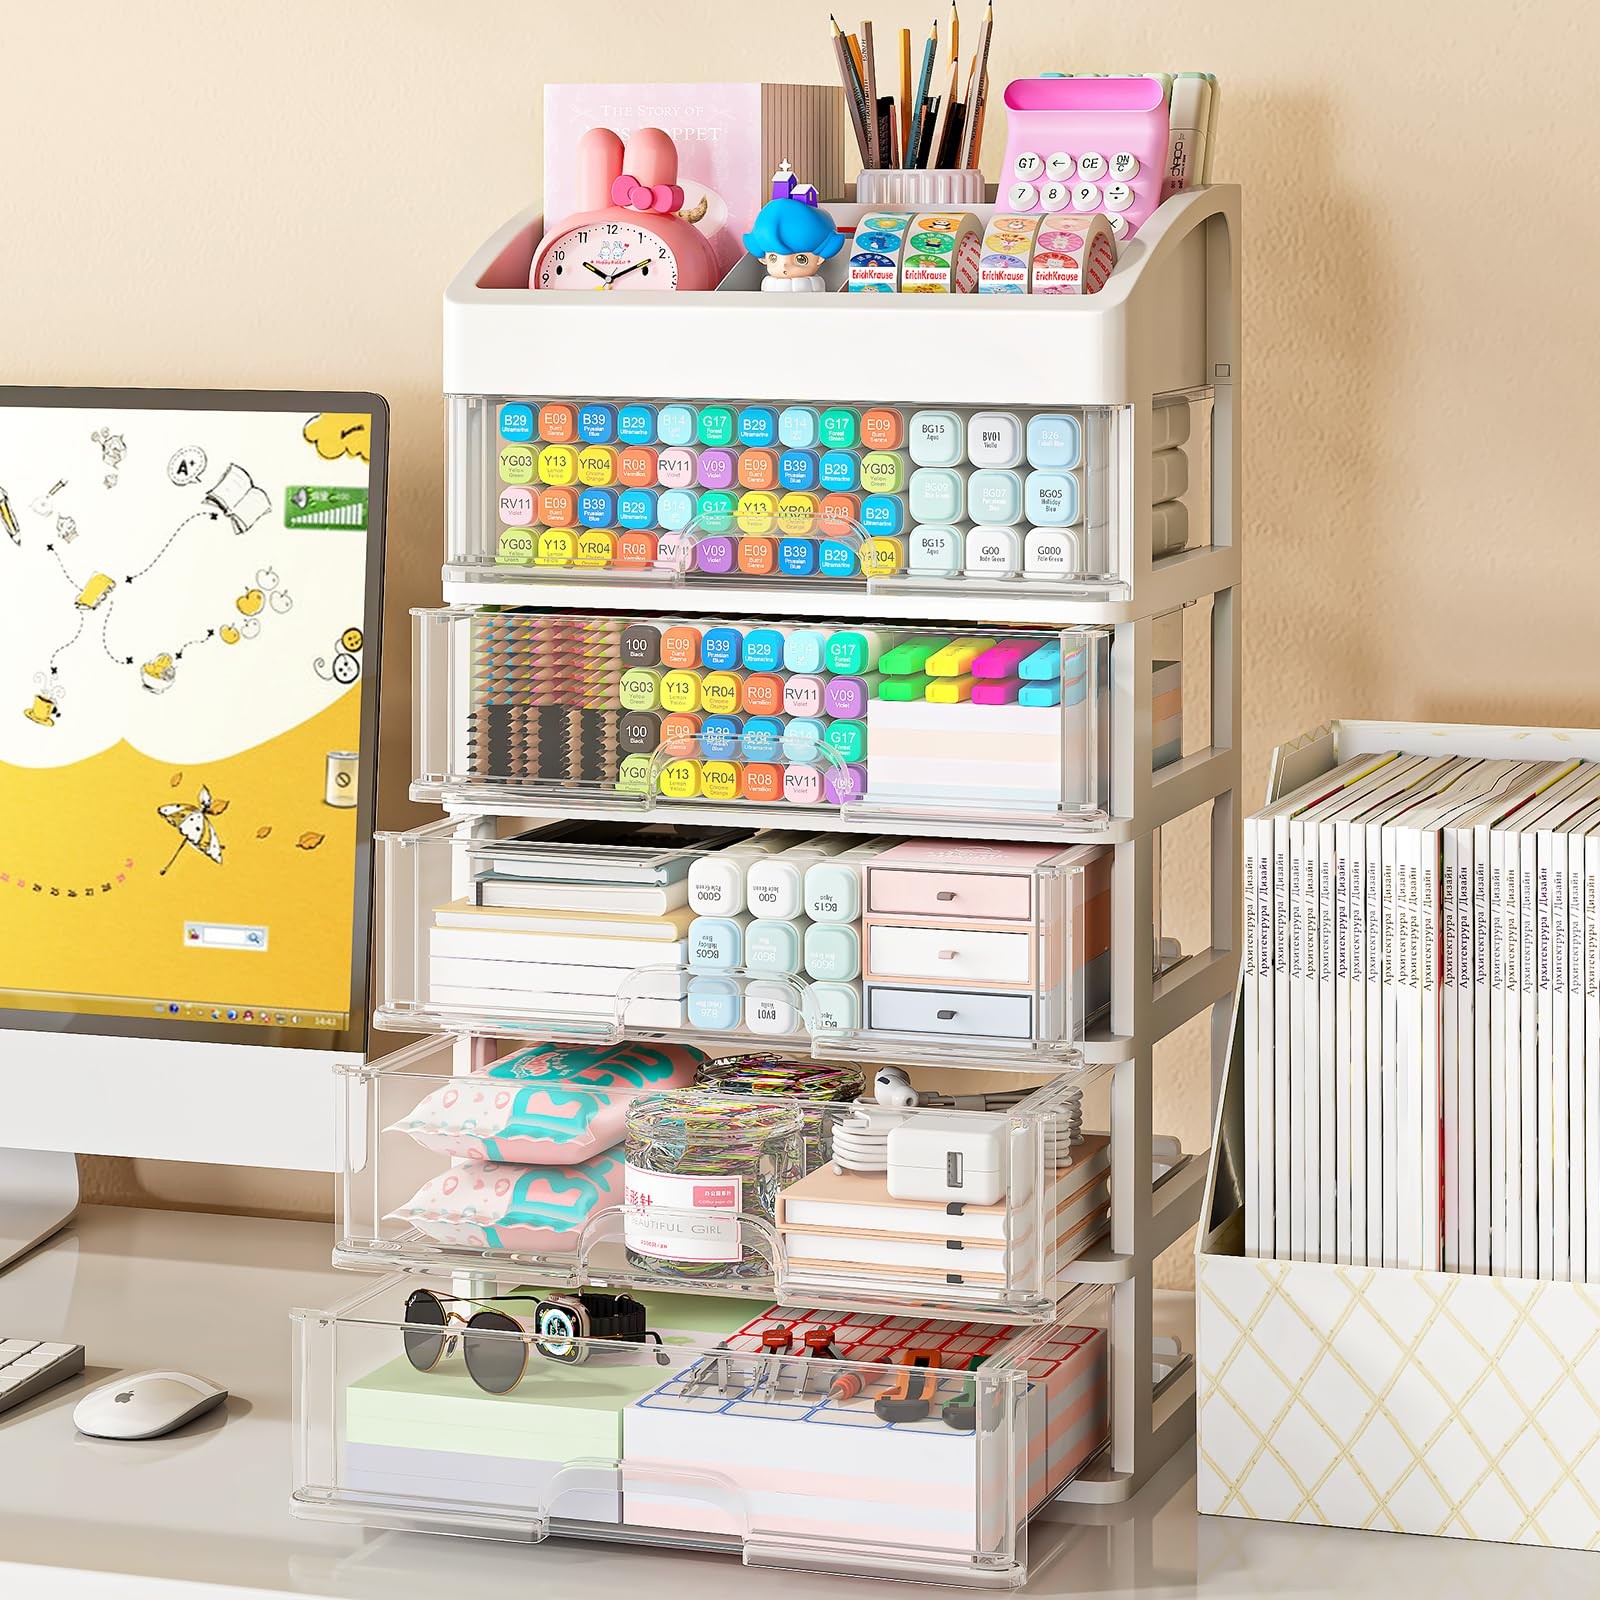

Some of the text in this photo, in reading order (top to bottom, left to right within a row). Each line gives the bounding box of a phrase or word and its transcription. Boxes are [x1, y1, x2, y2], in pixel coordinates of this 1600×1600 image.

[639, 105, 680, 117] STORY
[685, 106, 704, 116] OF
[1019, 158, 1035, 168] GT
[1083, 158, 1098, 168] CE
[1018, 189, 1025, 198] 7
[1049, 189, 1057, 199] 8
[1081, 189, 1089, 199] 9
[606, 225, 618, 234] 12
[578, 232, 587, 243] 11
[638, 233, 642, 243] 1
[554, 251, 564, 260] 10
[659, 249, 666, 258] 2
[542, 274, 549, 284] 9
[852, 270, 893, 279] ErichKrause
[905, 270, 946, 280] ErichKrause
[982, 271, 1024, 280] ErichKrause
[1036, 272, 1078, 280] ErichKrause
[504, 415, 526, 425] B29
[544, 413, 566, 424] E09
[583, 414, 605, 424] B39
[623, 418, 645, 428] B29
[703, 416, 726, 426] G17
[744, 419, 766, 430] B29
[825, 419, 848, 429] G17
[868, 420, 890, 430] E09
[922, 425, 944, 433] BG15
[983, 432, 1000, 441] BV01
[501, 456, 532, 466] YG03
[544, 456, 566, 466] Y13
[580, 459, 610, 469] YR04
[623, 460, 646, 470] R08
[659, 460, 689, 470] RV11
[703, 461, 725, 471] V09
[744, 460, 767, 470] E09
[784, 461, 806, 471] B39
[825, 464, 847, 474] B29
[862, 464, 895, 474] YG03
[1040, 490, 1062, 498] BG05
[501, 499, 531, 509] RV11
[544, 498, 566, 508] E09
[583, 499, 605, 509] B39
[623, 502, 645, 512] B29
[703, 502, 726, 512] G17
[744, 503, 766, 512] Y13
[866, 509, 889, 519] B29
[501, 539, 532, 549] YG03
[544, 540, 566, 550] Y13
[580, 543, 610, 553] YR04
[922, 539, 944, 547] BG15
[623, 544, 646, 554] R08
[703, 546, 725, 556] V09
[744, 545, 767, 555] E09
[784, 547, 806, 557] B39
[982, 547, 999, 555] G00
[1038, 547, 1061, 555] G000
[825, 551, 847, 561] B29
[626, 640, 647, 650] 100
[667, 639, 689, 649] E09
[707, 640, 729, 651] B39
[748, 645, 770, 655] B29
[831, 644, 856, 655] G17
[621, 682, 653, 693] YG03
[667, 683, 688, 693] Y13
[703, 686, 734, 696] YR04
[748, 688, 771, 698] R08
[786, 689, 816, 699] RV11
[831, 690, 854, 701] V09
[626, 726, 647, 737] 100
[831, 733, 856, 743] G17
[667, 769, 688, 779] Y13
[703, 773, 734, 783] YR04
[748, 775, 771, 785] R08
[786, 776, 816, 786] RV11
[698, 892, 721, 900] G000
[759, 894, 776, 902] G00
[814, 902, 837, 911] BG15
[1245, 857, 1255, 976] Архитектура Дизайн
[1260, 858, 1269, 977] Архитектура Дизайн
[1276, 853, 1286, 973] Архитектура Дизайн
[1338, 858, 1347, 978] Архитектура Дизайн
[1352, 862, 1361, 982] Архитектура Дизайн
[1384, 865, 1393, 985] Архитектура Дизайн
[1398, 864, 1408, 984] Архитектура Дизайн
[1444, 867, 1454, 987] Архитектура Дизайн
[1476, 863, 1486, 984] Архитектура Дизайн
[1423, 870, 1433, 991] Архитектура Дизайн
[1459, 868, 1469, 988] Архитектура Дизайн
[1492, 869, 1502, 989] Архитектура Дизайн
[1539, 868, 1549, 989] Архитектура Дизайн
[1554, 872, 1564, 993] Архитектура Дизайн
[1587, 876, 1597, 997] Архитектура Дизайн
[1292, 907, 1301, 978] Архитектура
[1306, 908, 1315, 979] Архитектура
[696, 949, 719, 958] BG05
[1507, 918, 1517, 991] Архитектура
[758, 1009, 775, 1019] BV01
